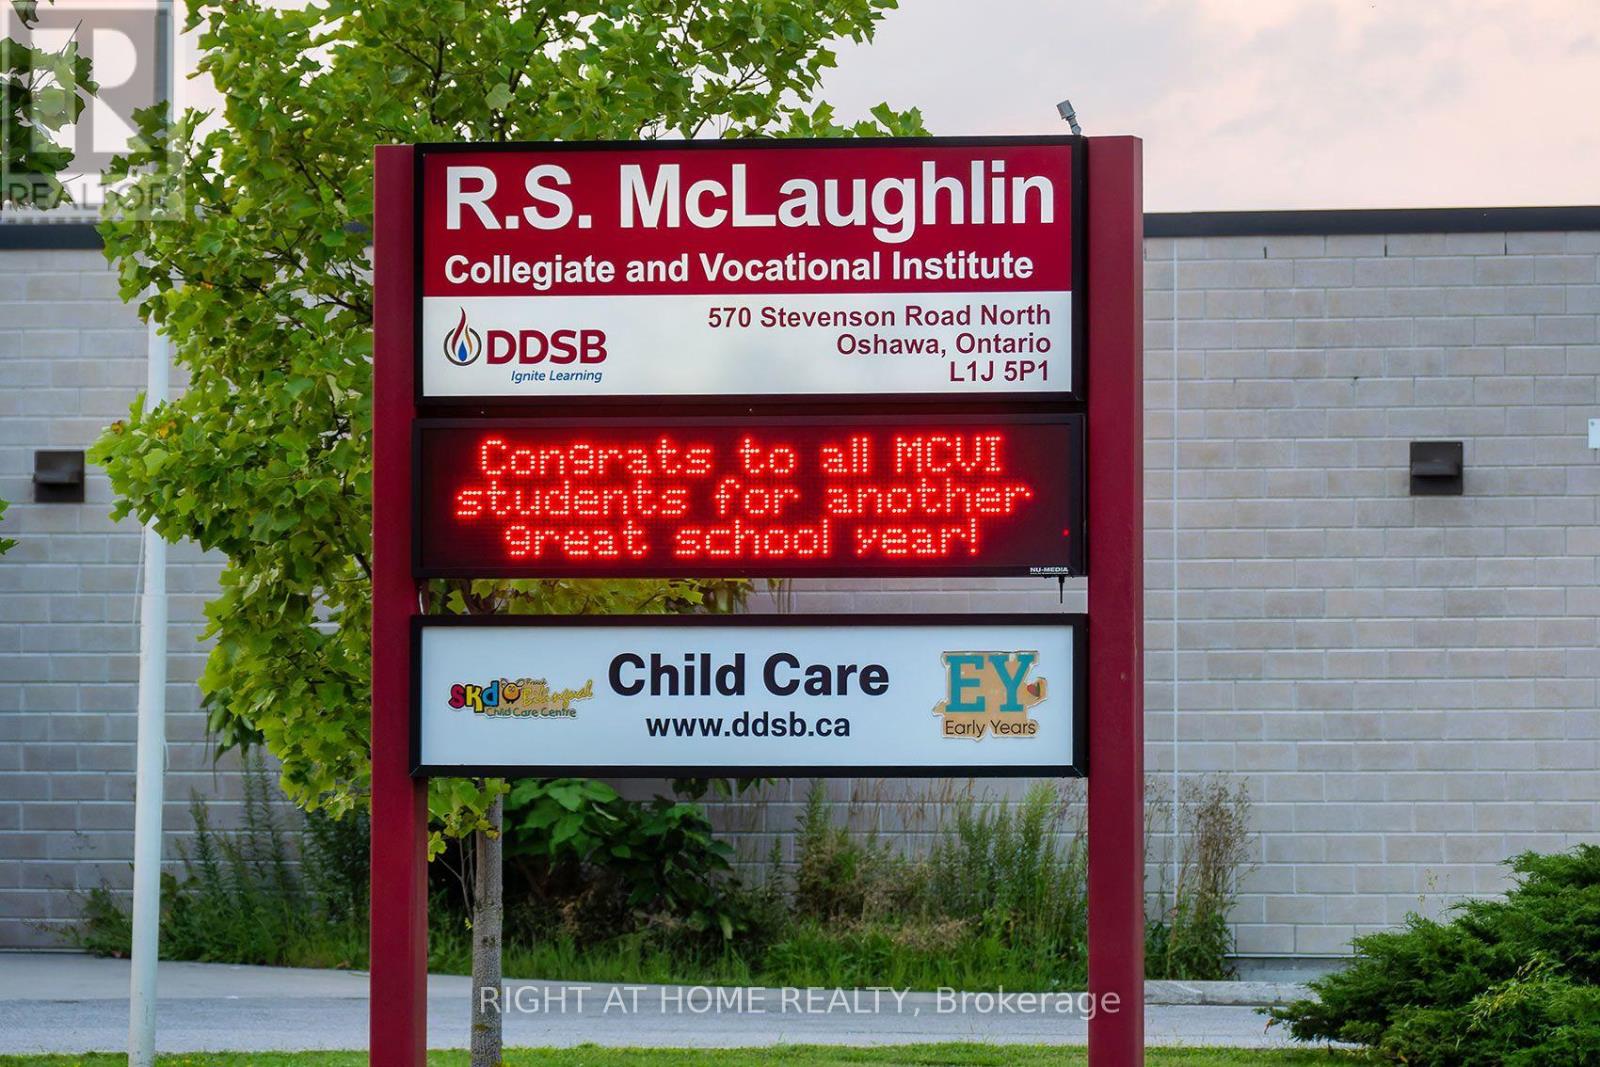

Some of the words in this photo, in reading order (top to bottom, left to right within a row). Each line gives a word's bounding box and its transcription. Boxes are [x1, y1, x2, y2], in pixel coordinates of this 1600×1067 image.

[446, 164, 592, 230] R.S.
[620, 159, 1054, 244] McLaughlin
[444, 254, 616, 291] Collegiate
[626, 253, 689, 283] and
[699, 251, 880, 282] Vocational
[892, 250, 1034, 280] Institute
[708, 306, 752, 329] 570
[760, 305, 896, 328] Stevenson
[904, 305, 971, 327] Road
[980, 303, 1051, 326] North
[486, 329, 608, 365] DDSB
[836, 334, 947, 358] Oshawa,
[955, 333, 1052, 354] Ontario
[511, 370, 546, 384] Ignite
[549, 369, 603, 383] Learning
[949, 361, 994, 383] L1J
[1003, 360, 1050, 382] 5P1
[481, 437, 711, 475] Congrats
[739, 437, 795, 474] to
[823, 436, 868, 473] all
[456, 478, 688, 516] students
[715, 477, 799, 515] for
[824, 476, 1032, 514] another
[505, 519, 648, 556] great
[675, 518, 829, 556] school
[857, 517, 976, 555] year!
[608, 652, 746, 697] Child
[762, 652, 890, 697] Care
[945, 654, 1036, 713] EY
[486, 706, 512, 718] Child
[512, 707, 539, 718] Care
[540, 706, 577, 718] Centre
[645, 710, 850, 738] www.ddsb.ca
[945, 719, 986, 738] Early
[990, 719, 1037, 735] Years
